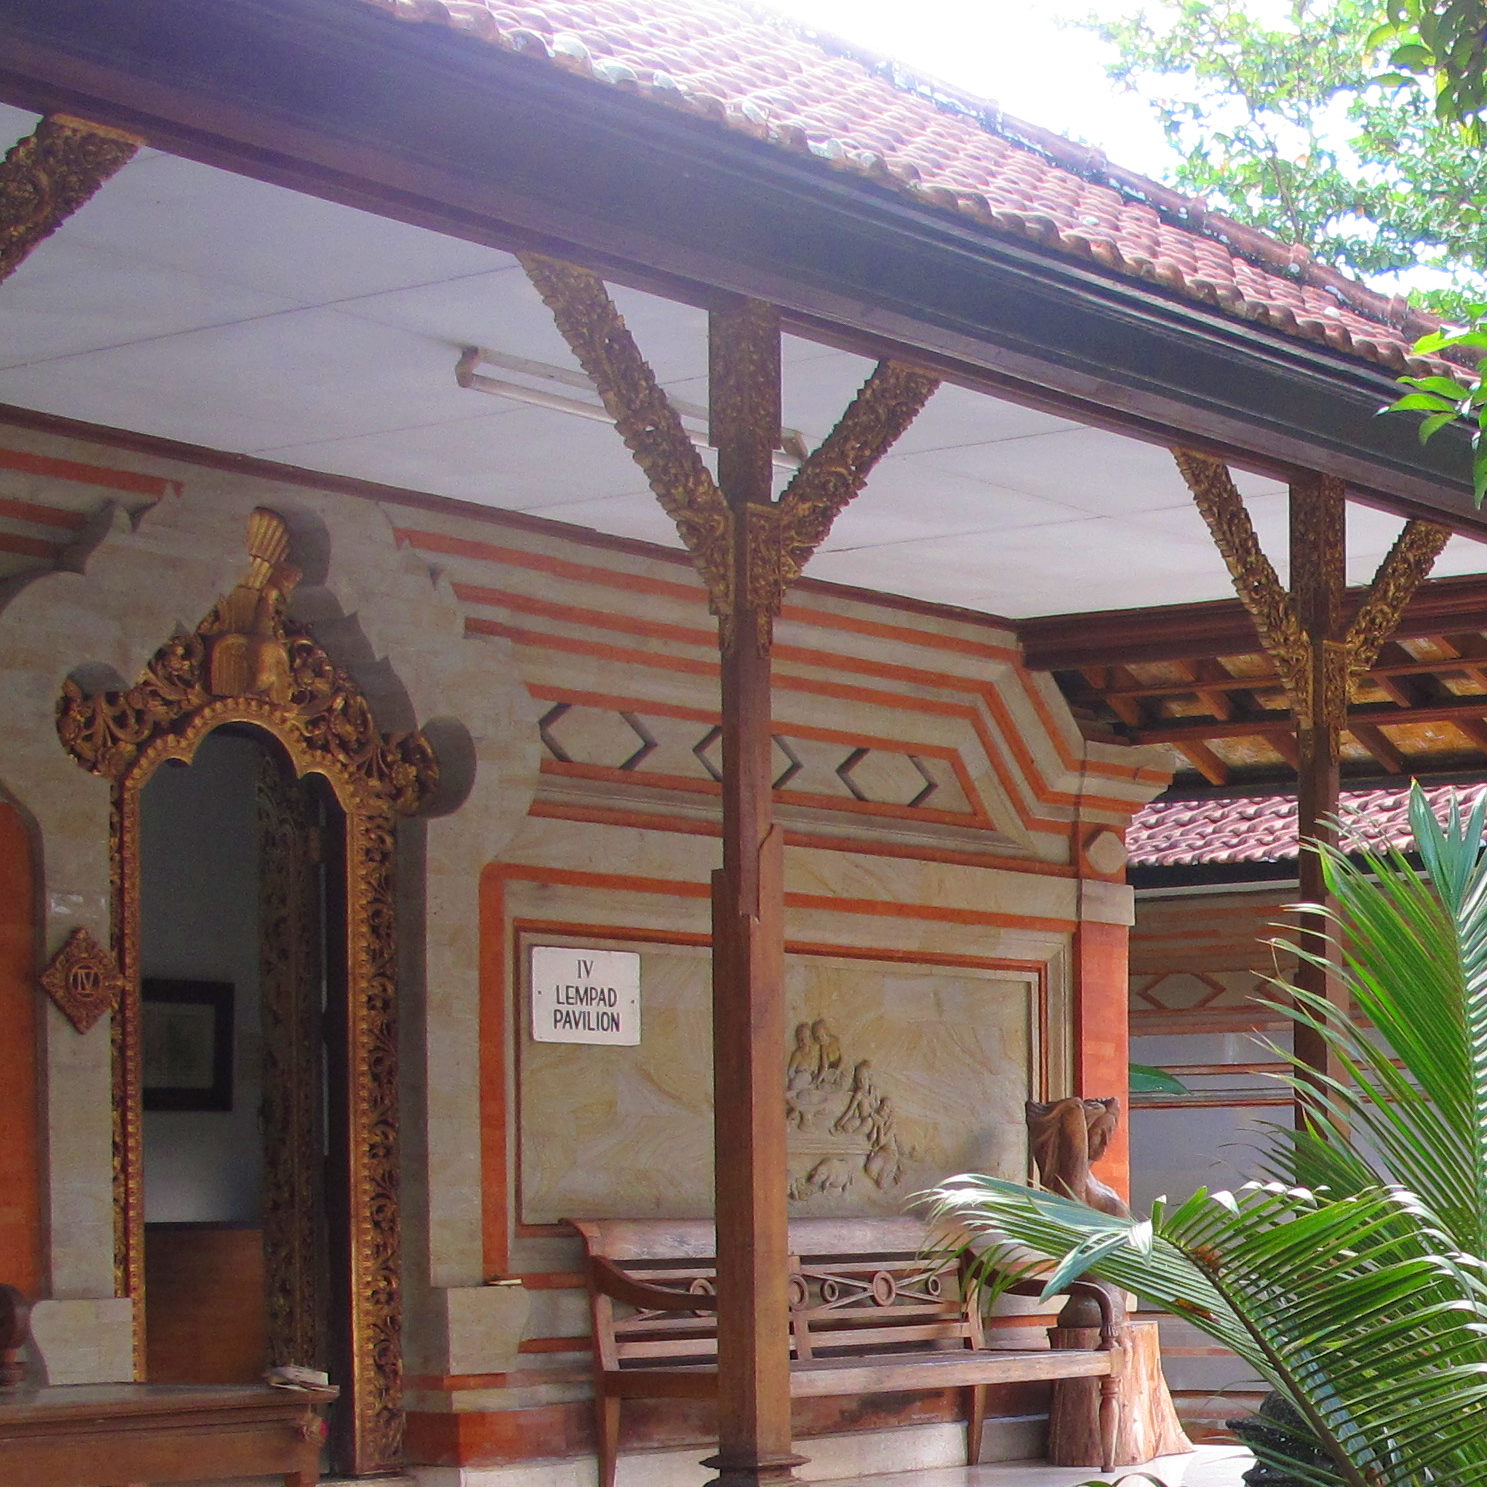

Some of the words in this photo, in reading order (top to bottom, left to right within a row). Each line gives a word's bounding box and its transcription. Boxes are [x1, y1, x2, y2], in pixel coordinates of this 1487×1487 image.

[577, 959, 594, 978] IV
[556, 985, 617, 1008] LEMPAD
[554, 1009, 620, 1032] PAVILION
